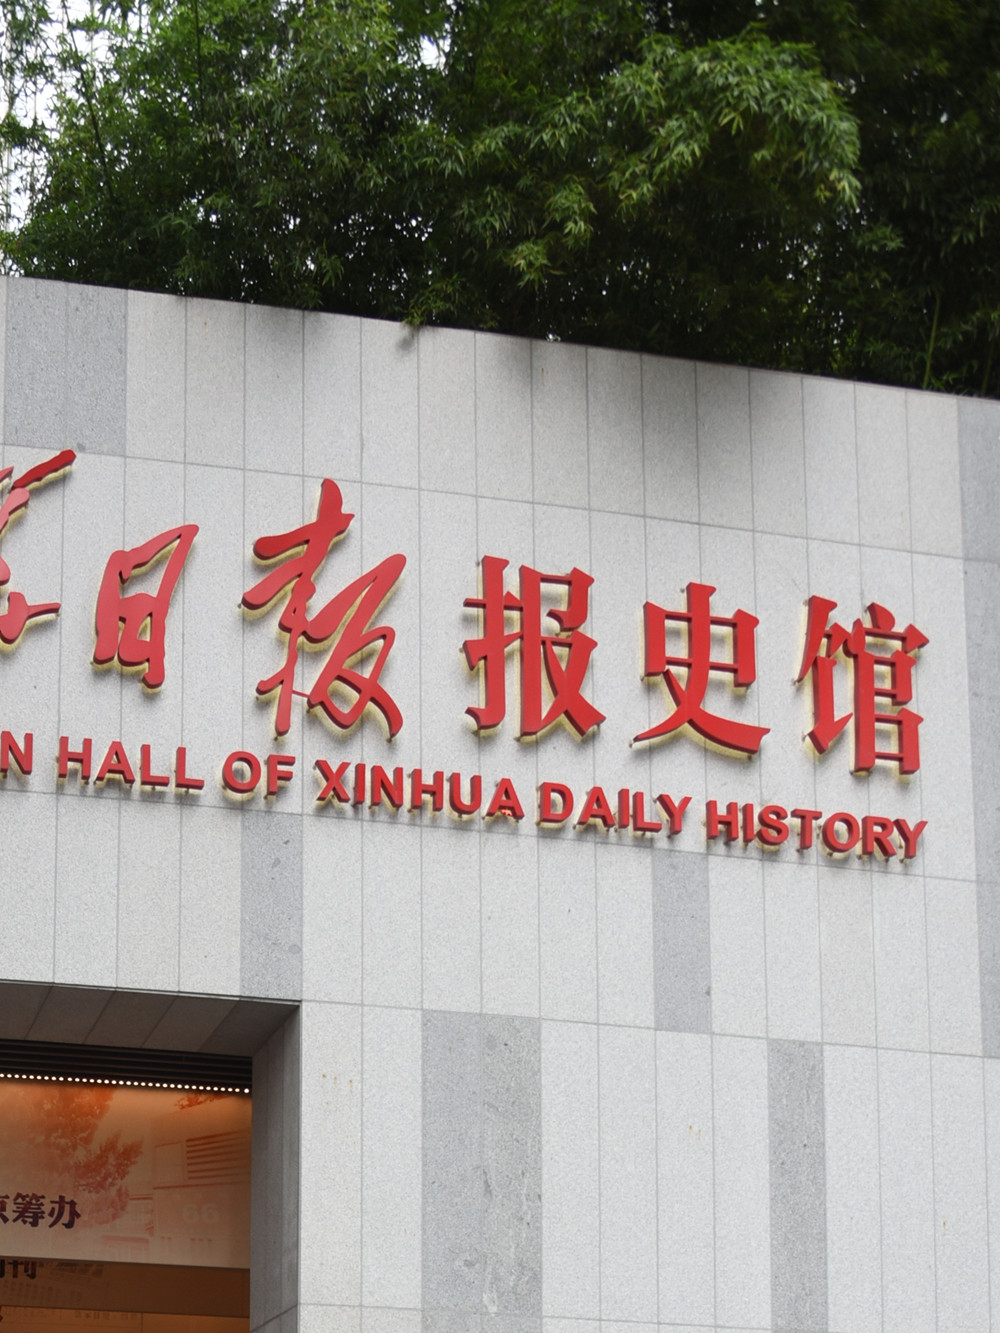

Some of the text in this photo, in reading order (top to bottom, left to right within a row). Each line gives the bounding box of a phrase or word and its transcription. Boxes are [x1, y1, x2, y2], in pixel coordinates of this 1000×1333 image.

[58, 735, 206, 790] HALL
[222, 749, 296, 797] OF
[315, 758, 525, 821] XINHUA
[538, 780, 693, 837] DAILY
[704, 800, 929, 860] HISTORY
